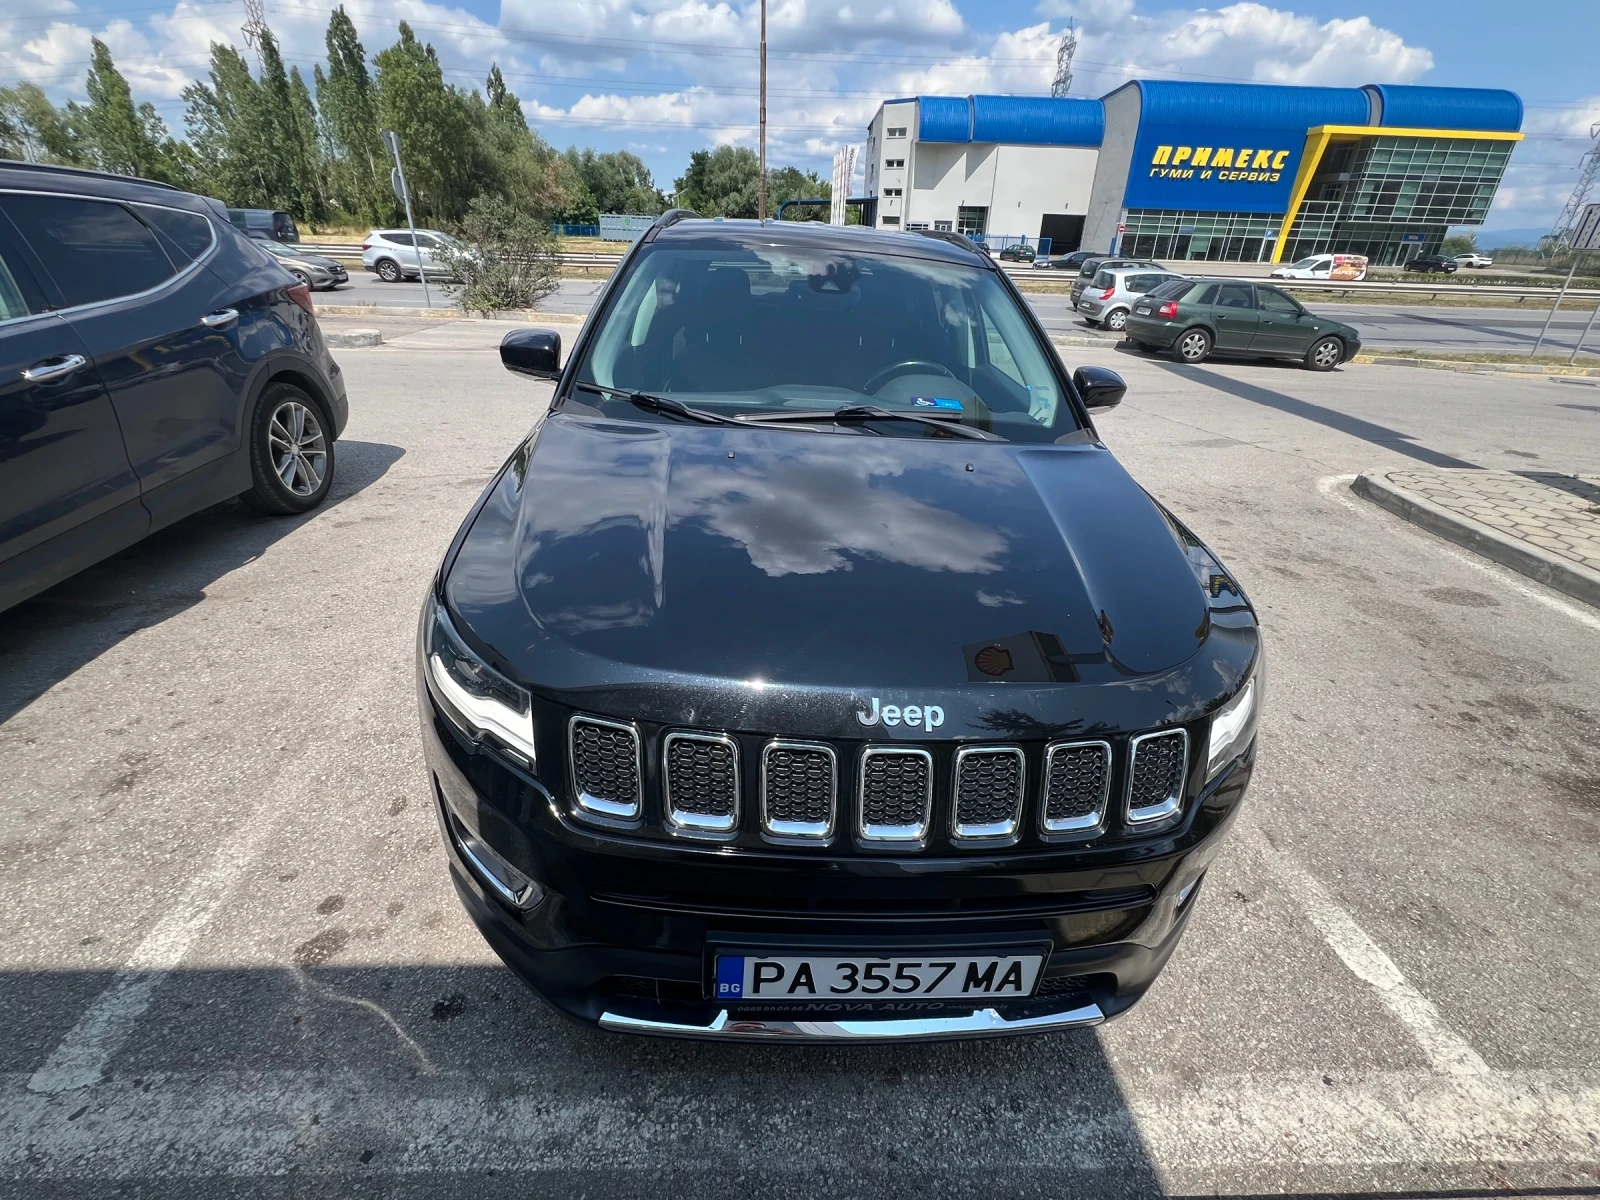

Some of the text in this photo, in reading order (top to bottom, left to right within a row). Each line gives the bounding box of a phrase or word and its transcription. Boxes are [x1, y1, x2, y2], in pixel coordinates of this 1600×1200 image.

[1152, 146, 1290, 169] ПРИМЕКС
[1150, 168, 1280, 182] ГУМИ И СЕРВИЗ
[856, 697, 945, 732] Jeep
[752, 960, 1023, 994] PA 3557 MA
[719, 983, 741, 993] BG
[805, 1002, 945, 1011] NOVA AUTO
